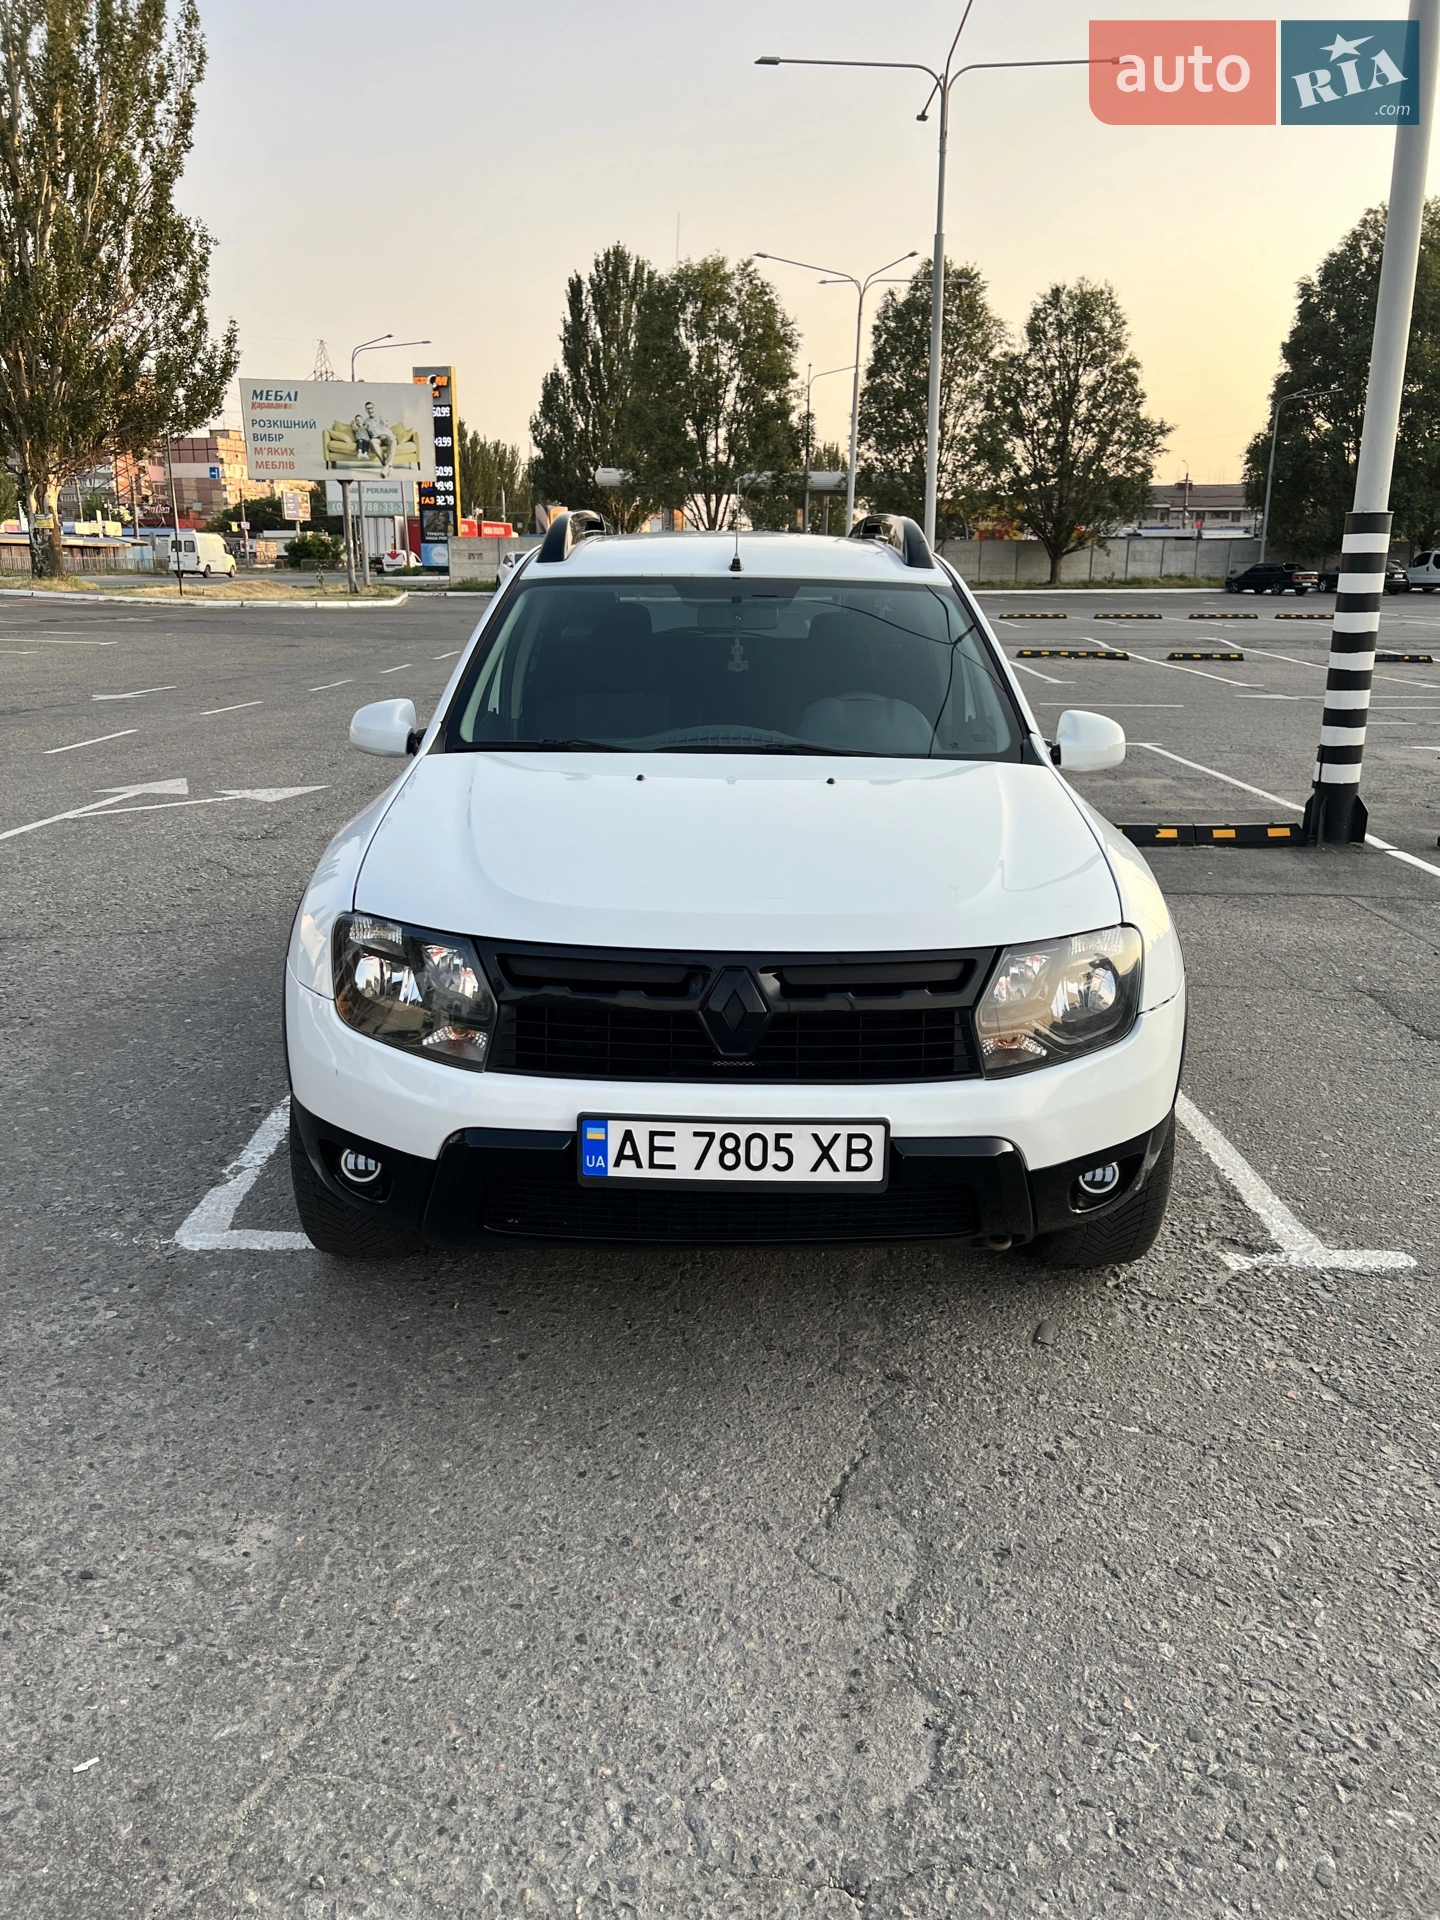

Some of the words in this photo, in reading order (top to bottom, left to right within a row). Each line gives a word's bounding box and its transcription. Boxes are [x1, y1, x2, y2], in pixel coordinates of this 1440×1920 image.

[251, 389, 299, 402] МЕБЛІ
[251, 401, 284, 410] Караван
[251, 418, 317, 429] РОЗКІШНИЙ
[252, 433, 284, 442] ВИБІР
[255, 461, 295, 470] МЕБЛІВ
[421, 496, 435, 504] ГАЗ
[613, 1129, 676, 1170] AE
[692, 1132, 794, 1172] 7805
[809, 1132, 873, 1172] XB
[586, 1155, 605, 1168] UA
